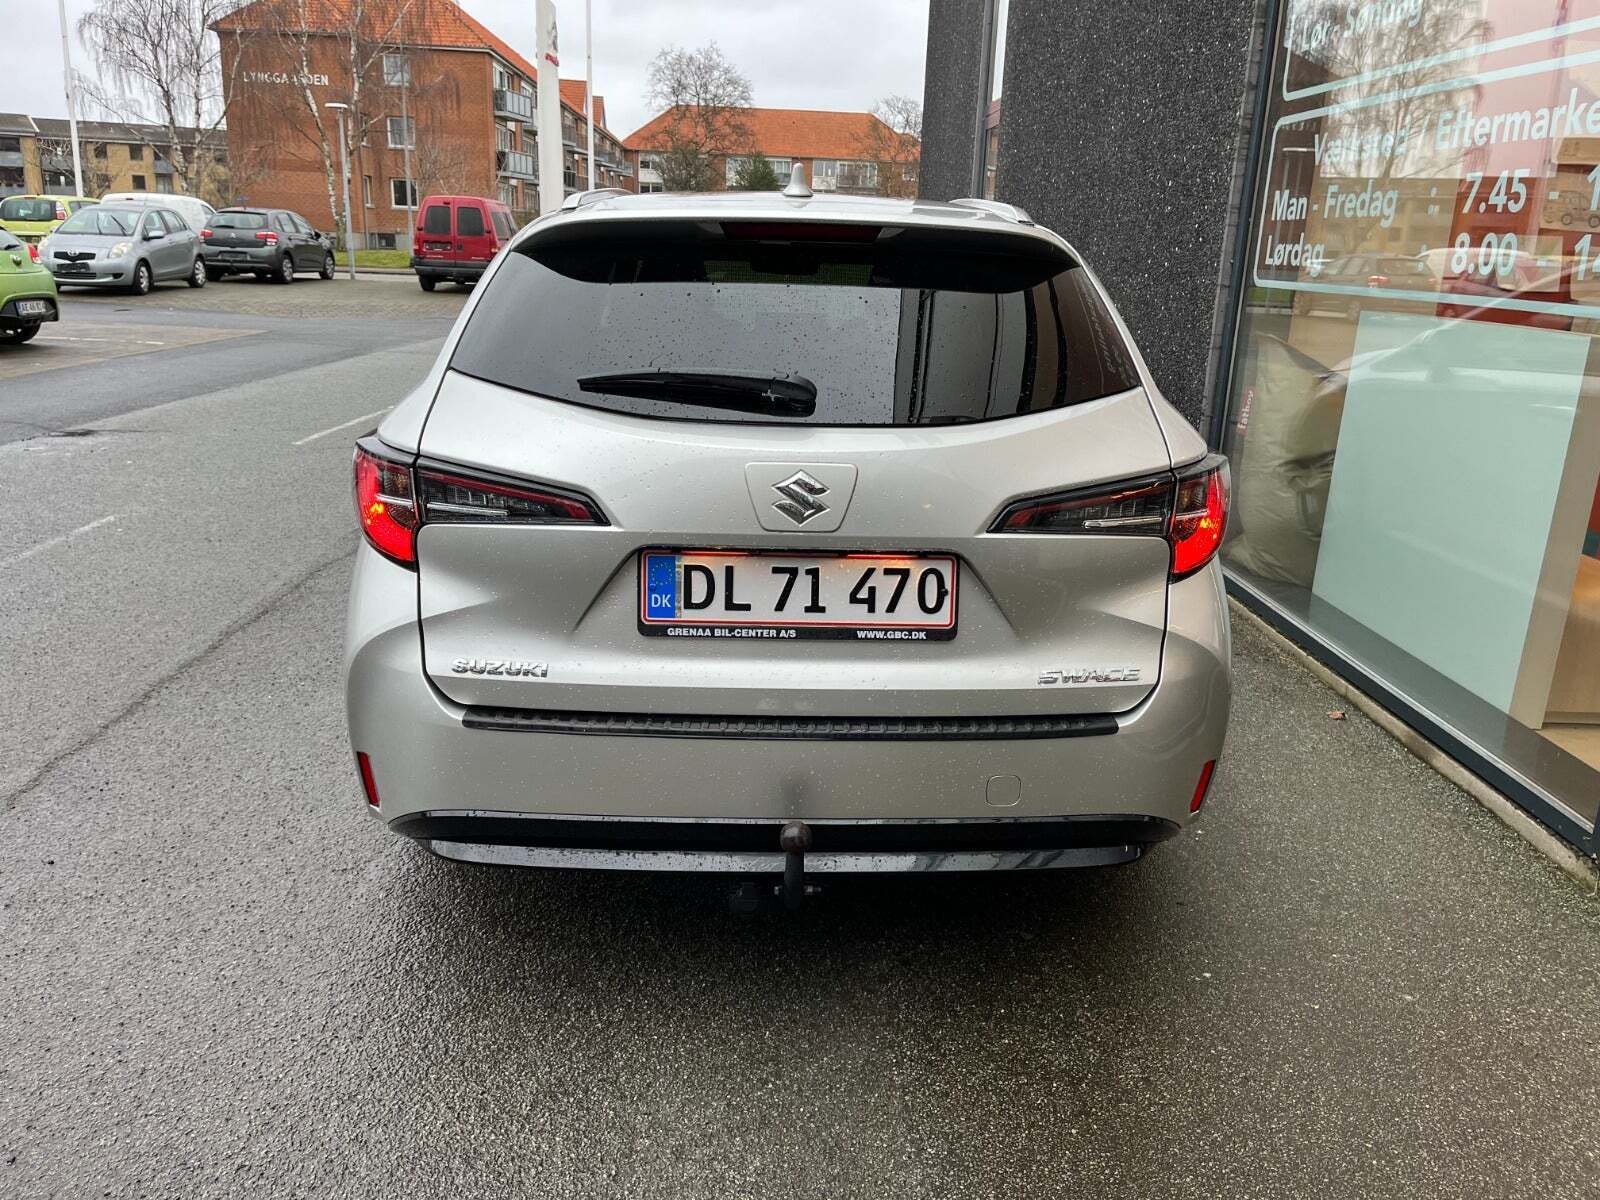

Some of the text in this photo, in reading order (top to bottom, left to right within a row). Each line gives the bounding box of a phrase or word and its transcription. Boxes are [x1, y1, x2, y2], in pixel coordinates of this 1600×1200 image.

[1271, 189, 1308, 221] Man
[1323, 179, 1399, 228] Fredag
[1462, 168, 1531, 214] 7.45
[1265, 232, 1325, 278] Lørdag
[1451, 232, 1518, 276] 8.00
[651, 563, 946, 615] DK DL 71 470
[667, 627, 927, 640] GRENAA BIL-CENTER A/S WWW.GBC.DK
[452, 658, 549, 679] SUZUKI
[1037, 667, 1141, 685] SWACE
